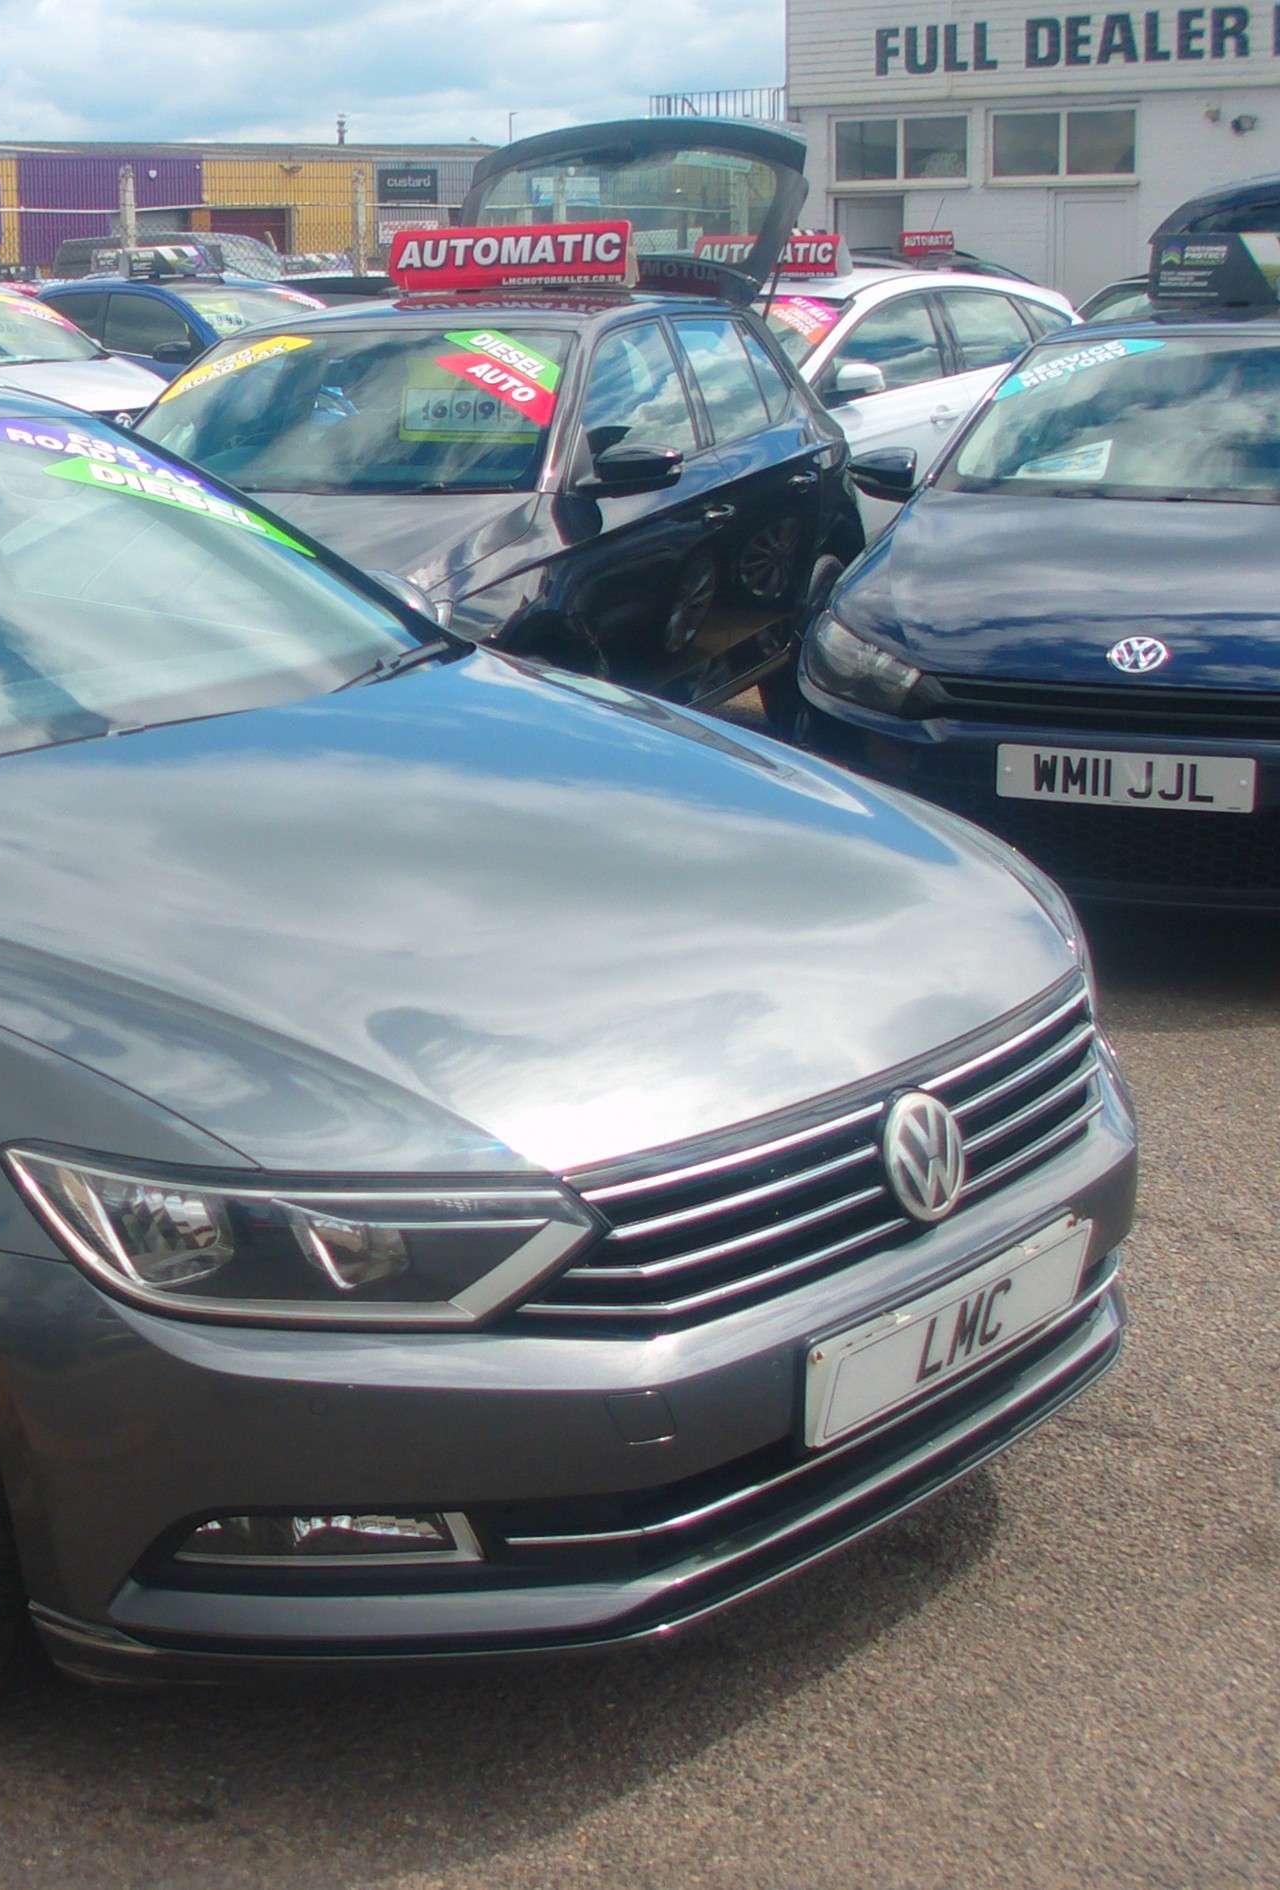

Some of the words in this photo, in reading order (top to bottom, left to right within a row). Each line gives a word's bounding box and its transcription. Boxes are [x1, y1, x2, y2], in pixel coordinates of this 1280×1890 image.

[876, 22, 997, 76] FULL
[1025, 7, 1250, 68] DEALER
[387, 174, 431, 188] custard
[397, 231, 621, 269] AUTOMATIC
[699, 242, 833, 264] AUTATIC
[502, 274, 622, 286] LMCMOTORSALES.CO.UK
[469, 333, 546, 379] DIESEL
[1018, 339, 1124, 380] SERVICE
[1021, 347, 1128, 387] HISTORY
[466, 362, 537, 402] AUTO
[6, 427, 117, 465] ROAD
[88, 463, 267, 534] DIESEL
[1033, 753, 1111, 797] WM11
[1127, 761, 1214, 803] JJL
[916, 1278, 1012, 1383] LMC
